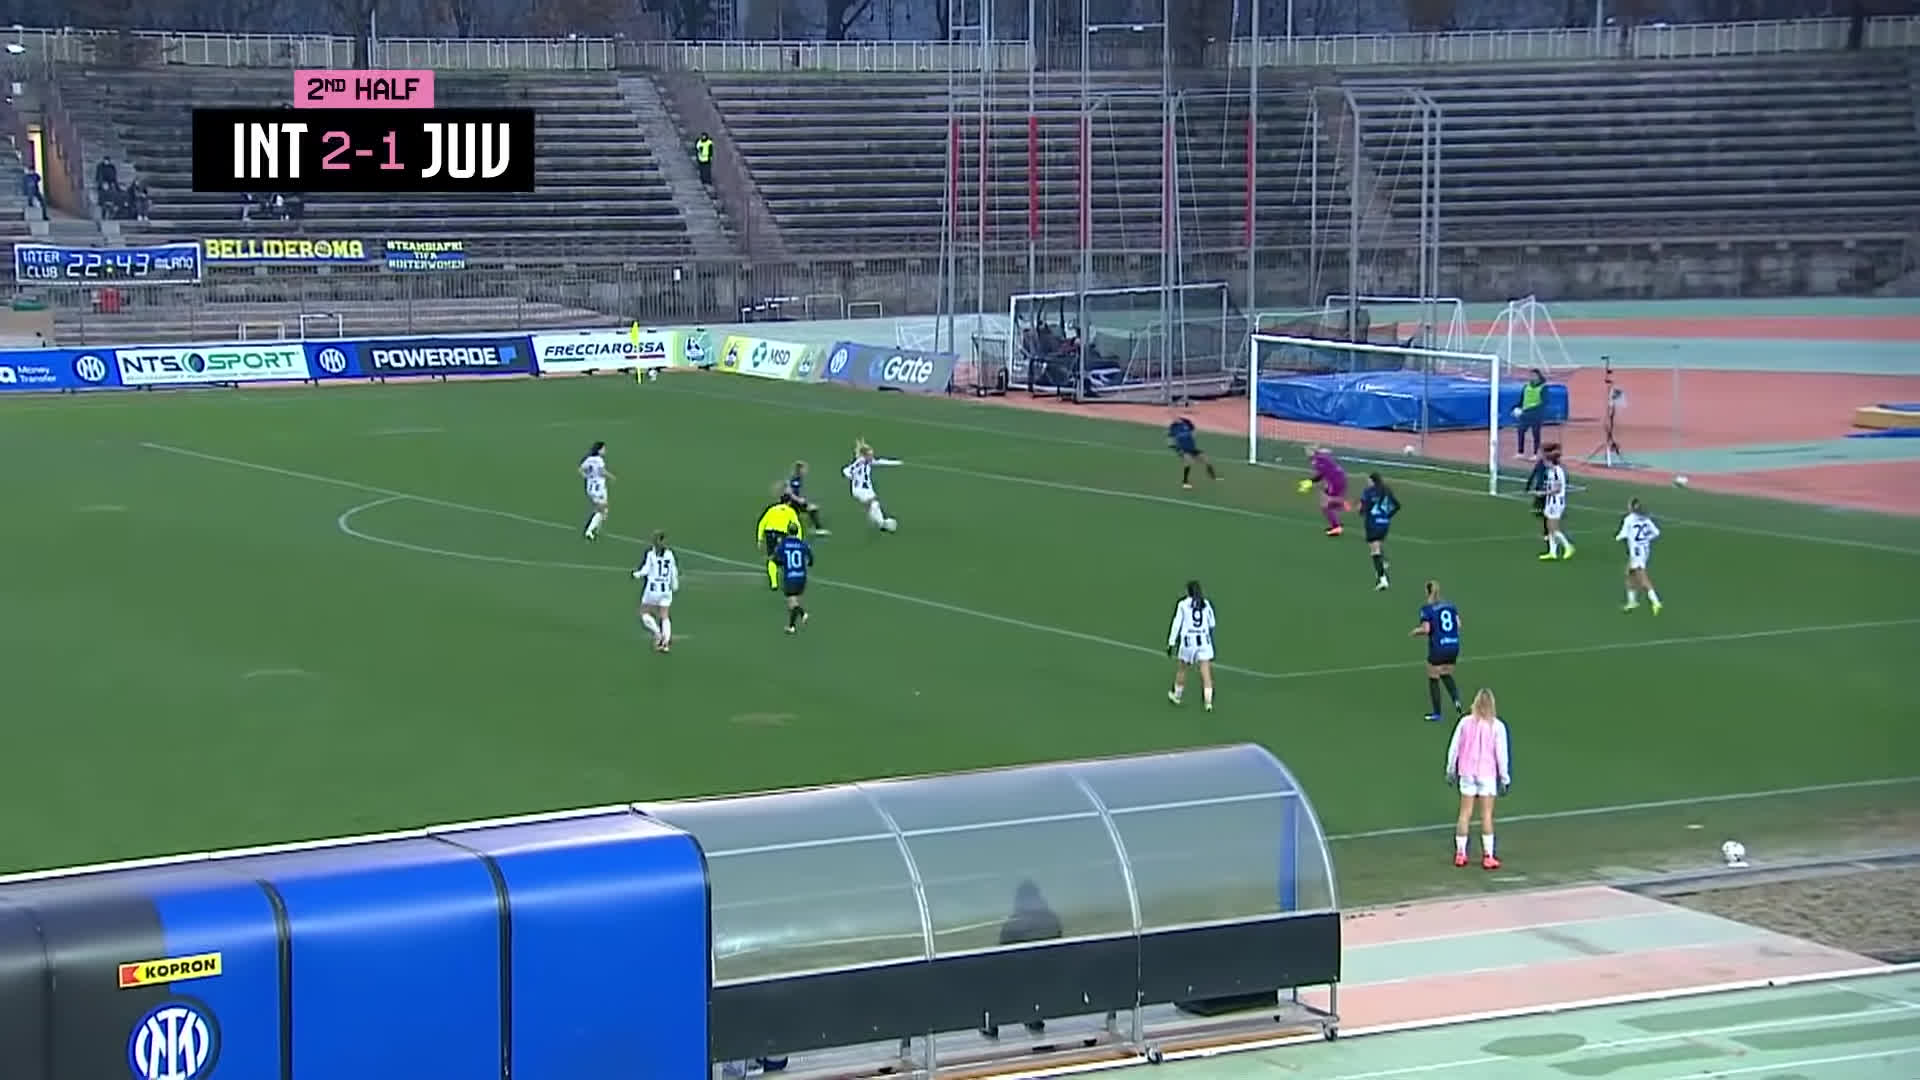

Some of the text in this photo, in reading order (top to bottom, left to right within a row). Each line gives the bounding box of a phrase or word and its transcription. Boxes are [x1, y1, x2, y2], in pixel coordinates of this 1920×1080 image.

[27, 265, 58, 278] CLUB
[66, 253, 149, 277] 22:43
[122, 352, 296, 373] NTS SPORT
[372, 347, 498, 368] POWERADE
[784, 549, 802, 570] 10
[1191, 607, 1204, 628] 9
[1440, 609, 1454, 632] 8
[145, 958, 216, 979] KOPRON
